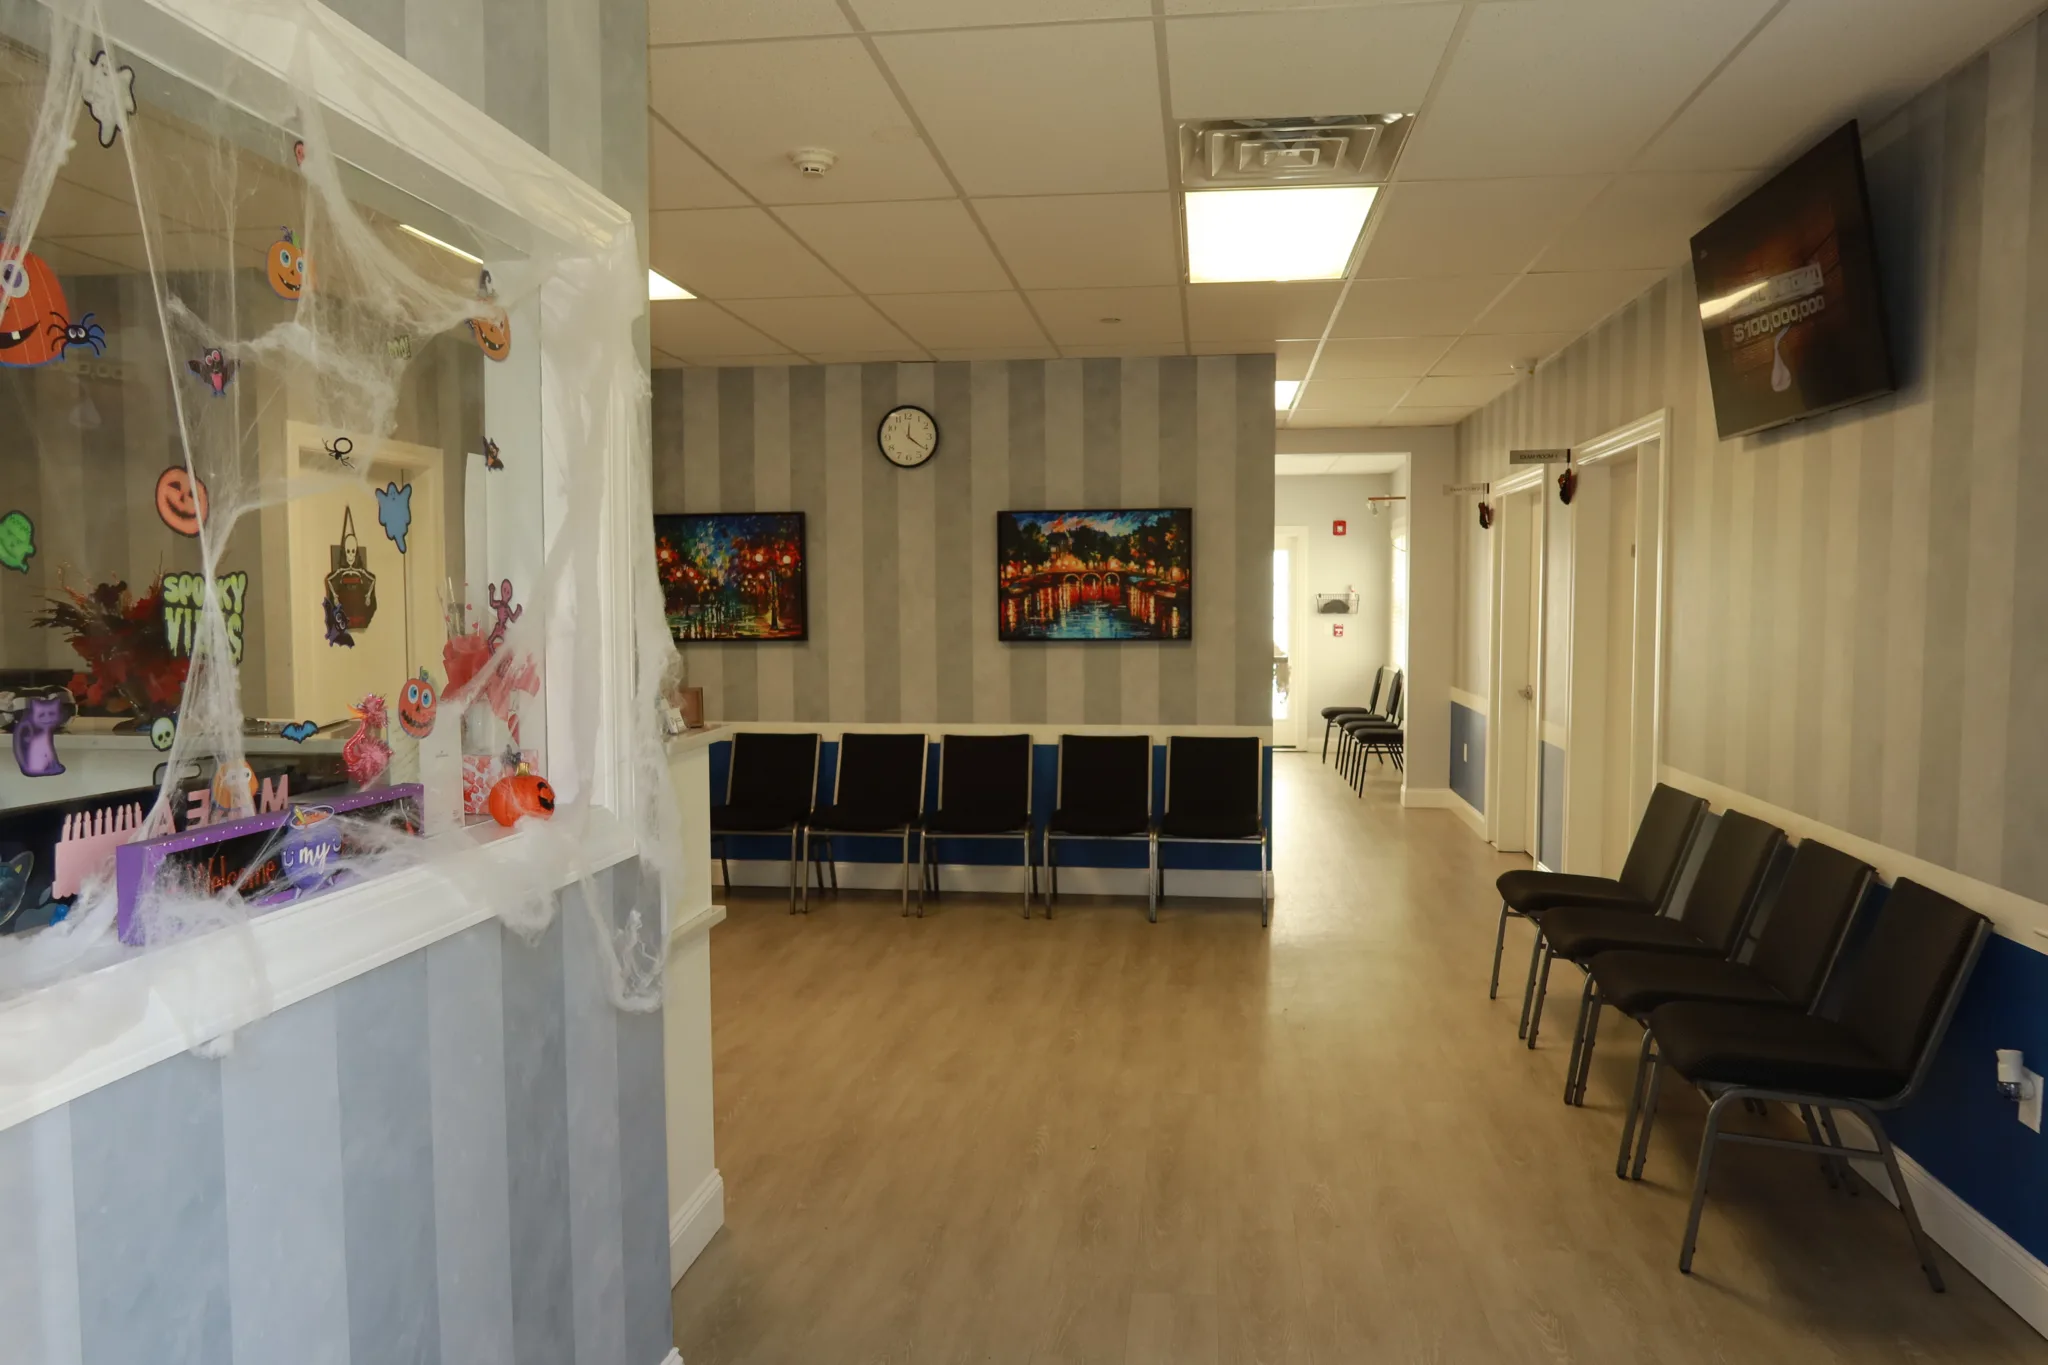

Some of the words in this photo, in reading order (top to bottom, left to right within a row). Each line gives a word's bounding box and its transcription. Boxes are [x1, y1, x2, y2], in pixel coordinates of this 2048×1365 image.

[163, 573, 247, 614] SPOKY
[164, 606, 243, 666] VIS
[299, 842, 331, 874] my
